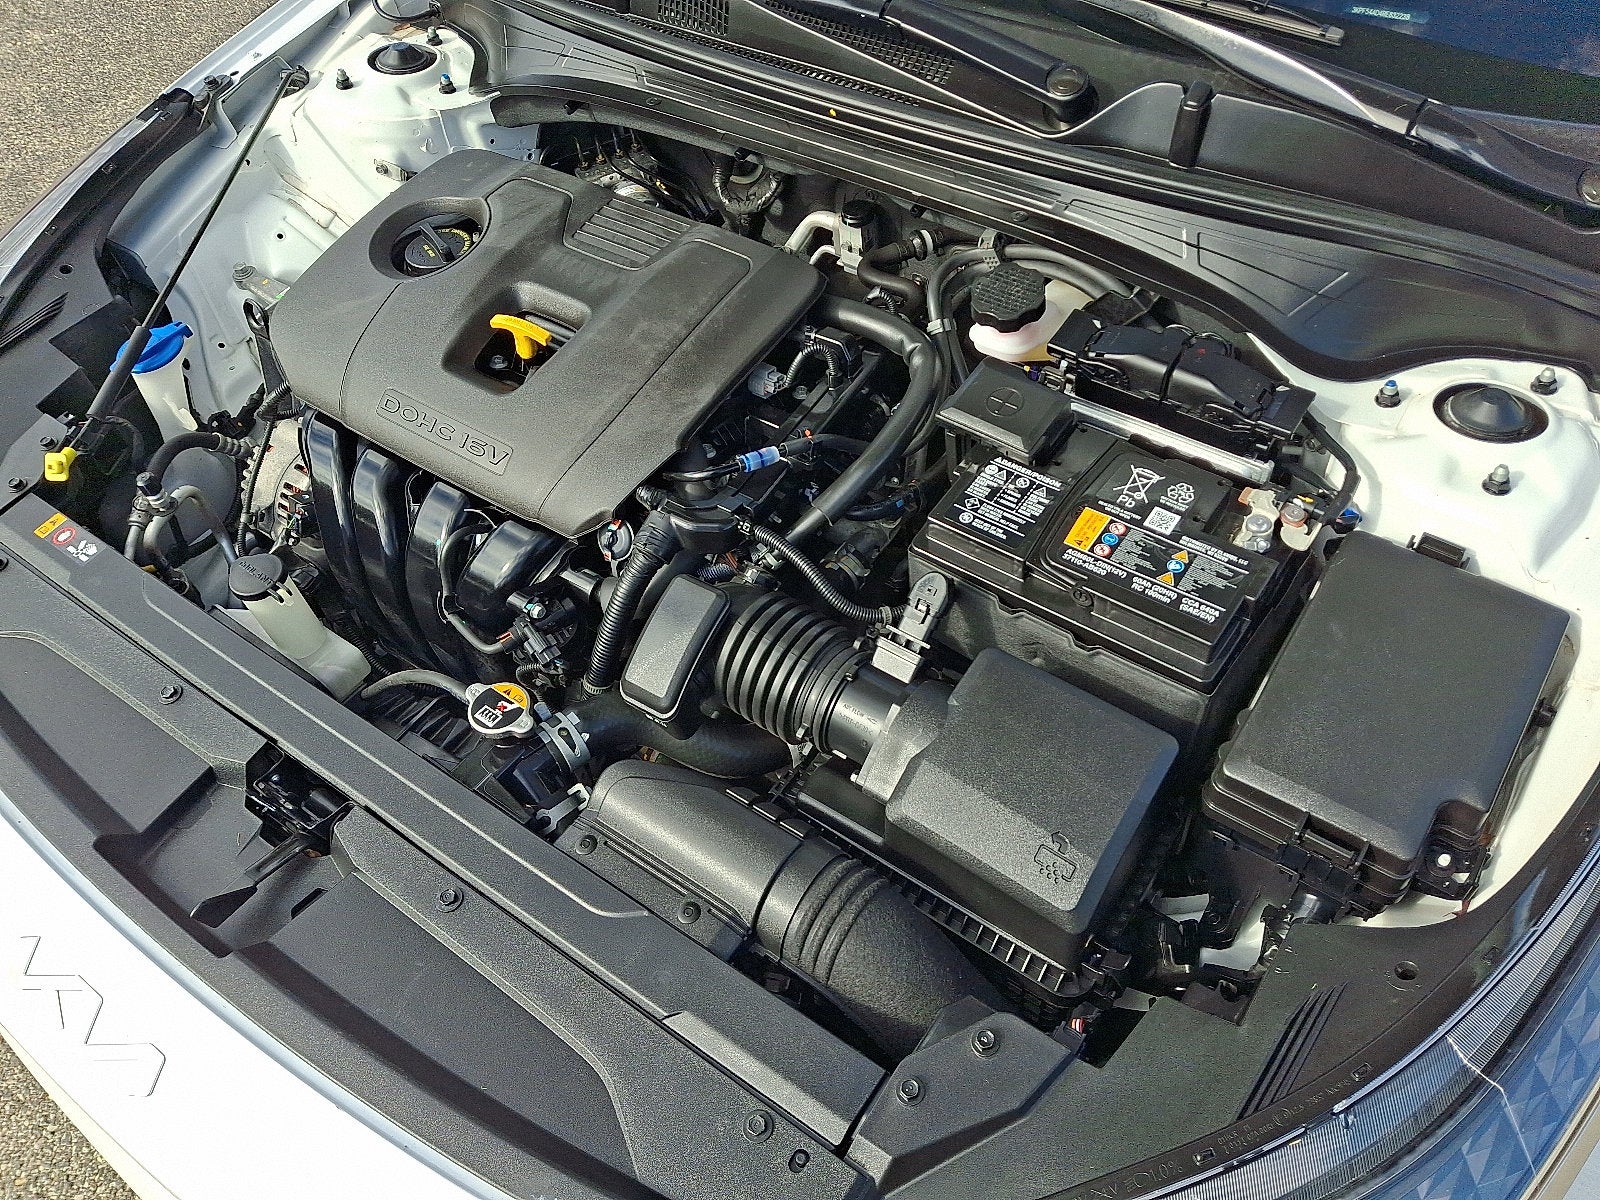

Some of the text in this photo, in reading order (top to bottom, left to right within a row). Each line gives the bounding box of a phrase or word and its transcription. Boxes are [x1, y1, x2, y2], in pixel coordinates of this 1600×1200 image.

[380, 394, 509, 465] DOHC 16V
[1000, 458, 1062, 488] DANGER/POISON
[1117, 494, 1136, 508] Pb
[1131, 583, 1171, 604] RC 100min
[1151, 584, 1177, 600] (20HR)
[1181, 597, 1199, 610] CCA
